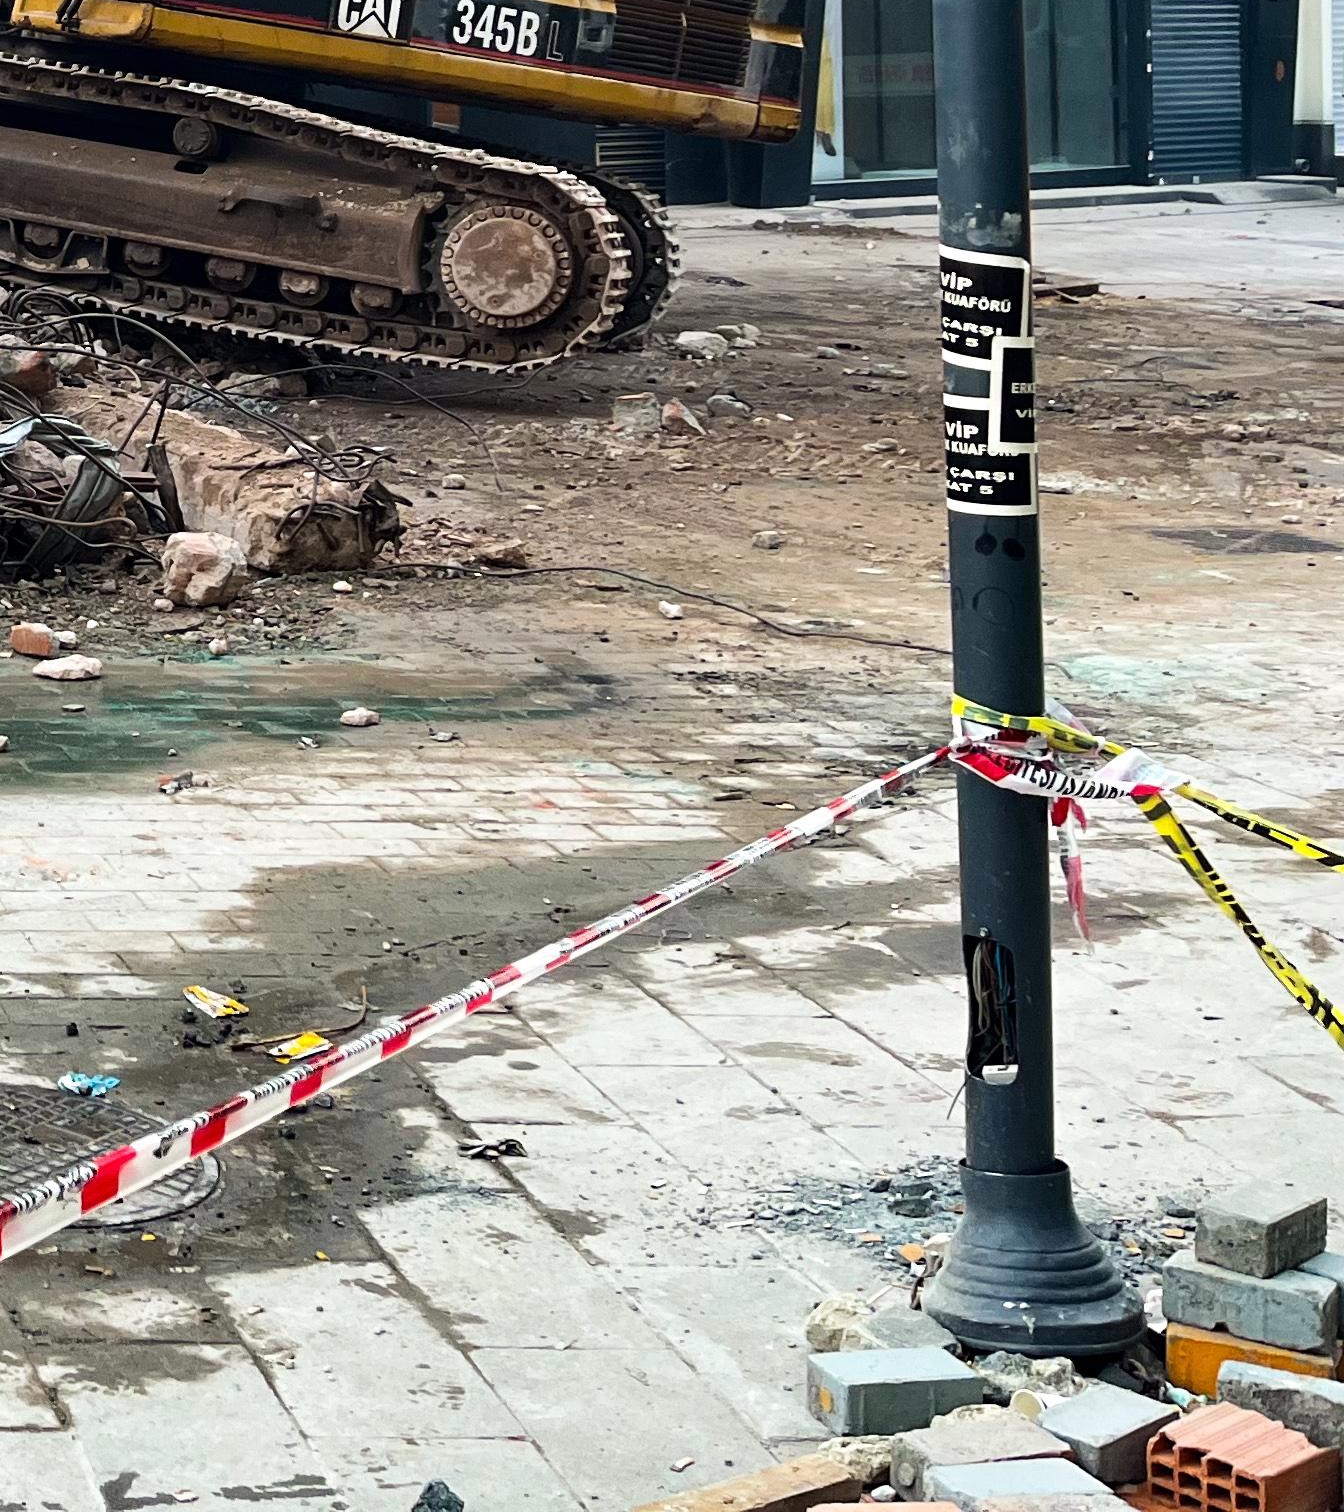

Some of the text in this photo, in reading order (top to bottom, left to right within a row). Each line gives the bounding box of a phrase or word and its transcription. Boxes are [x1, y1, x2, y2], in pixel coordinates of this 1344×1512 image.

[944, 291, 1011, 313] KUAFÖRÜ
[965, 338, 979, 347] 5
[945, 421, 979, 439] VİP
[950, 467, 1015, 483] ÇARŞI
[979, 485, 994, 495] 5
